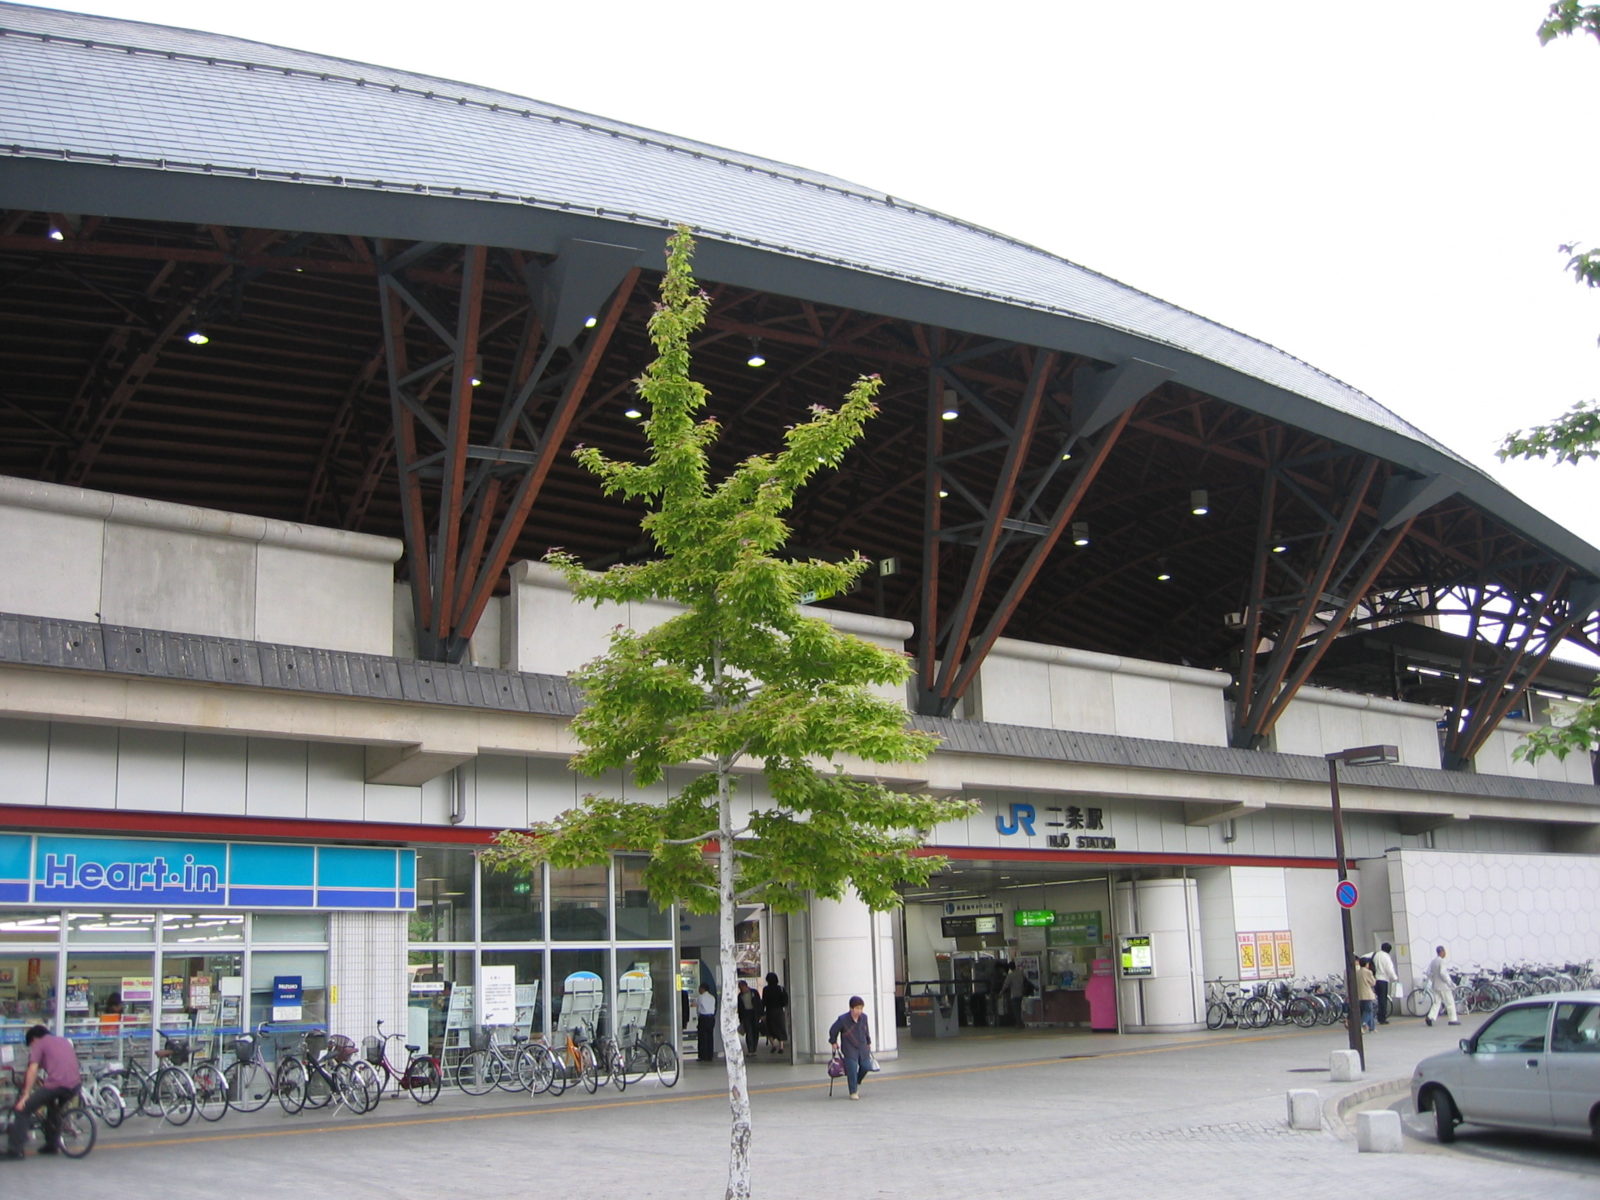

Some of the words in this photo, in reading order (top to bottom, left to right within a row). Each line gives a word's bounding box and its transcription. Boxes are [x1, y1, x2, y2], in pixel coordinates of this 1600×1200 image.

[996, 803, 1036, 836] JR
[1045, 806, 1104, 830] 二条駅
[1076, 836, 1116, 849] STATION
